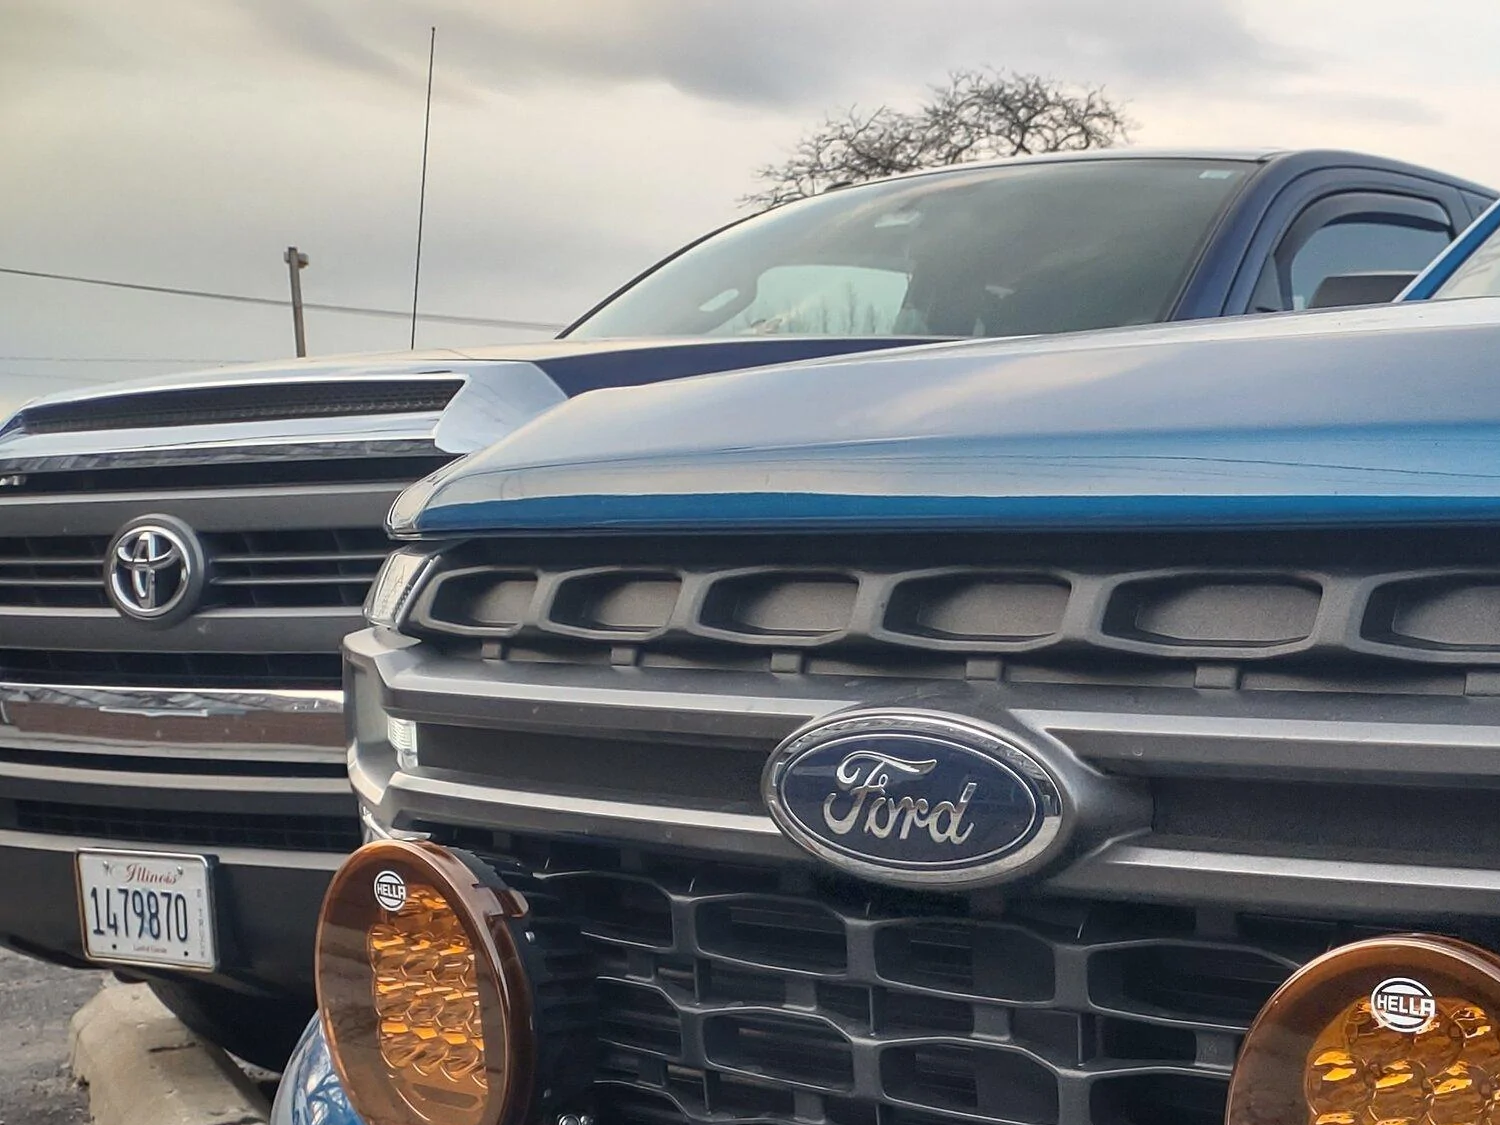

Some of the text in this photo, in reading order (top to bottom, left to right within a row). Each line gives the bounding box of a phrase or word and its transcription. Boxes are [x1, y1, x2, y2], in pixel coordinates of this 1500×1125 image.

[822, 750, 978, 845] Ford
[125, 864, 177, 885] Illinois
[377, 883, 406, 900] HELLA
[91, 886, 189, 943] 1479870
[1377, 994, 1436, 1018] HELLA
